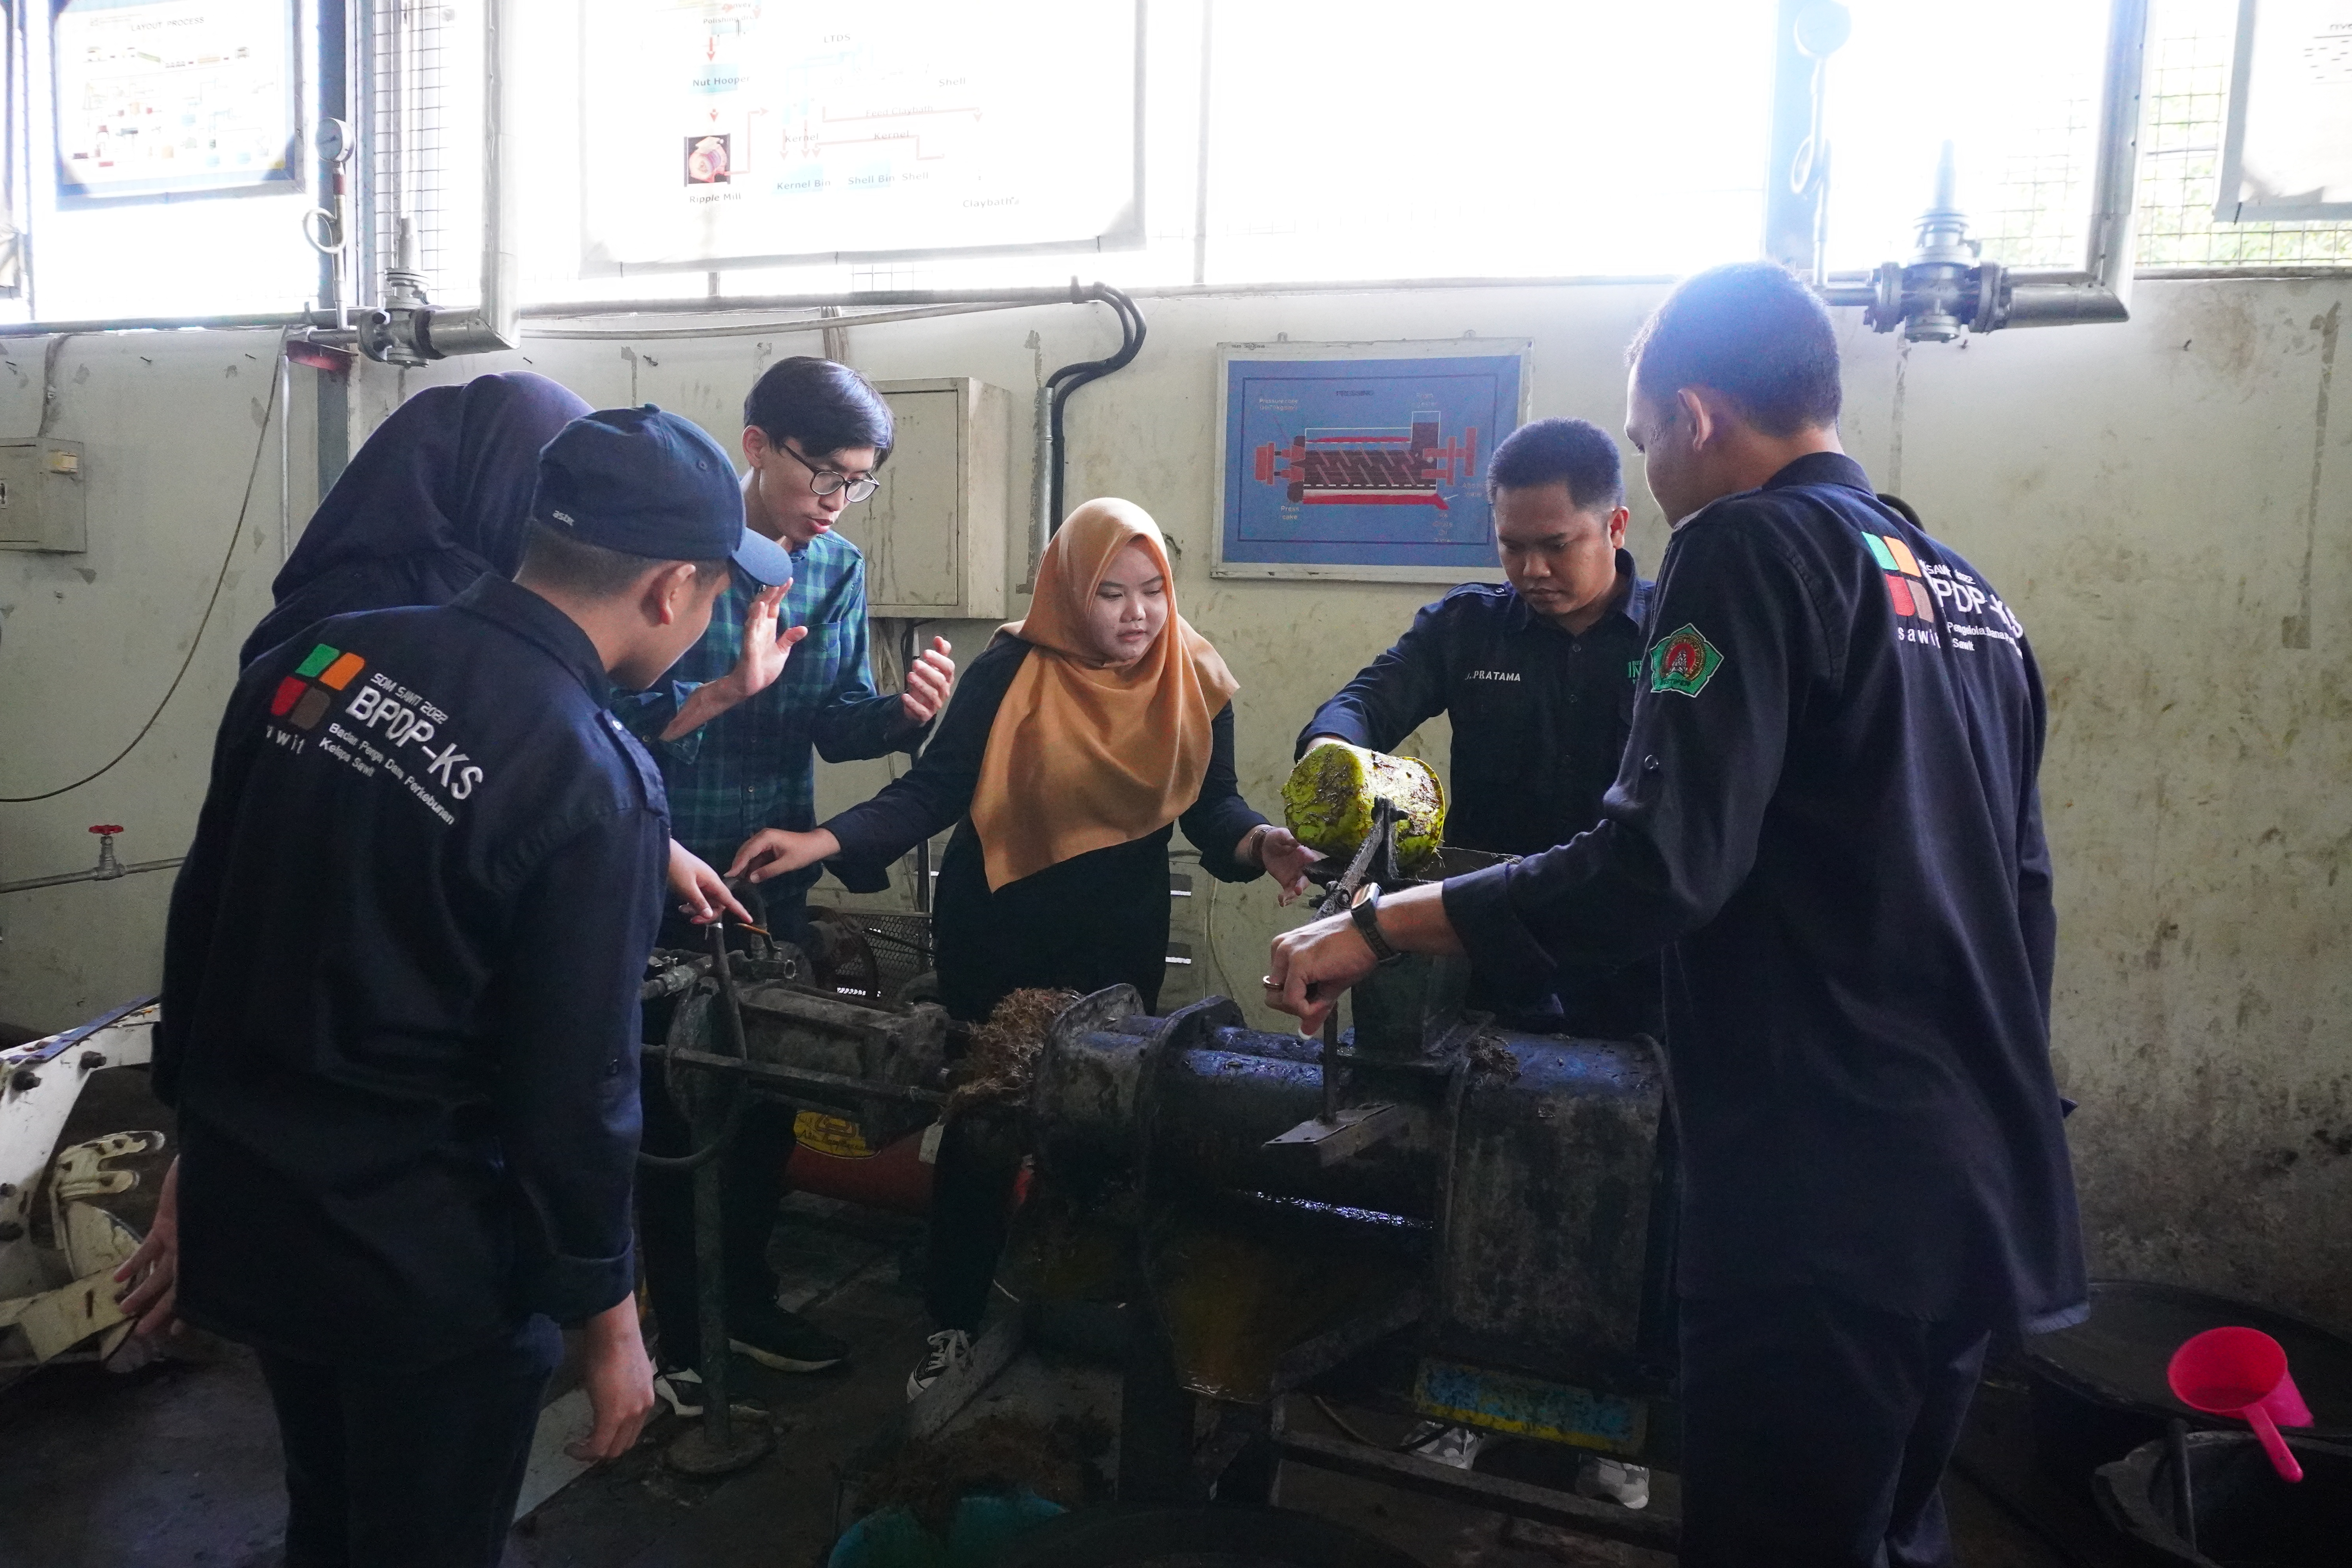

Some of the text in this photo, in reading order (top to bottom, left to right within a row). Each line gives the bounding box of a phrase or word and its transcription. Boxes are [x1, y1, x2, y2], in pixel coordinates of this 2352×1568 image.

[131, 16, 205, 31] LAYOUT PROCESS
[824, 33, 851, 43] LTDS
[714, 76, 751, 85] Hooper
[939, 77, 966, 87] Shell
[866, 105, 933, 117] Feed Claybath
[784, 133, 819, 143] Kernel
[874, 130, 909, 140] Kernel
[848, 174, 895, 185] Shell Bin
[902, 172, 929, 181] Shell
[777, 179, 831, 190] Kernel Bin
[690, 194, 719, 204] Ripple
[963, 197, 1012, 209] Claybath
[1473, 670, 1521, 682] PRATAMA
[419, 701, 449, 724] 2022
[345, 685, 483, 799] BPDP-KS
